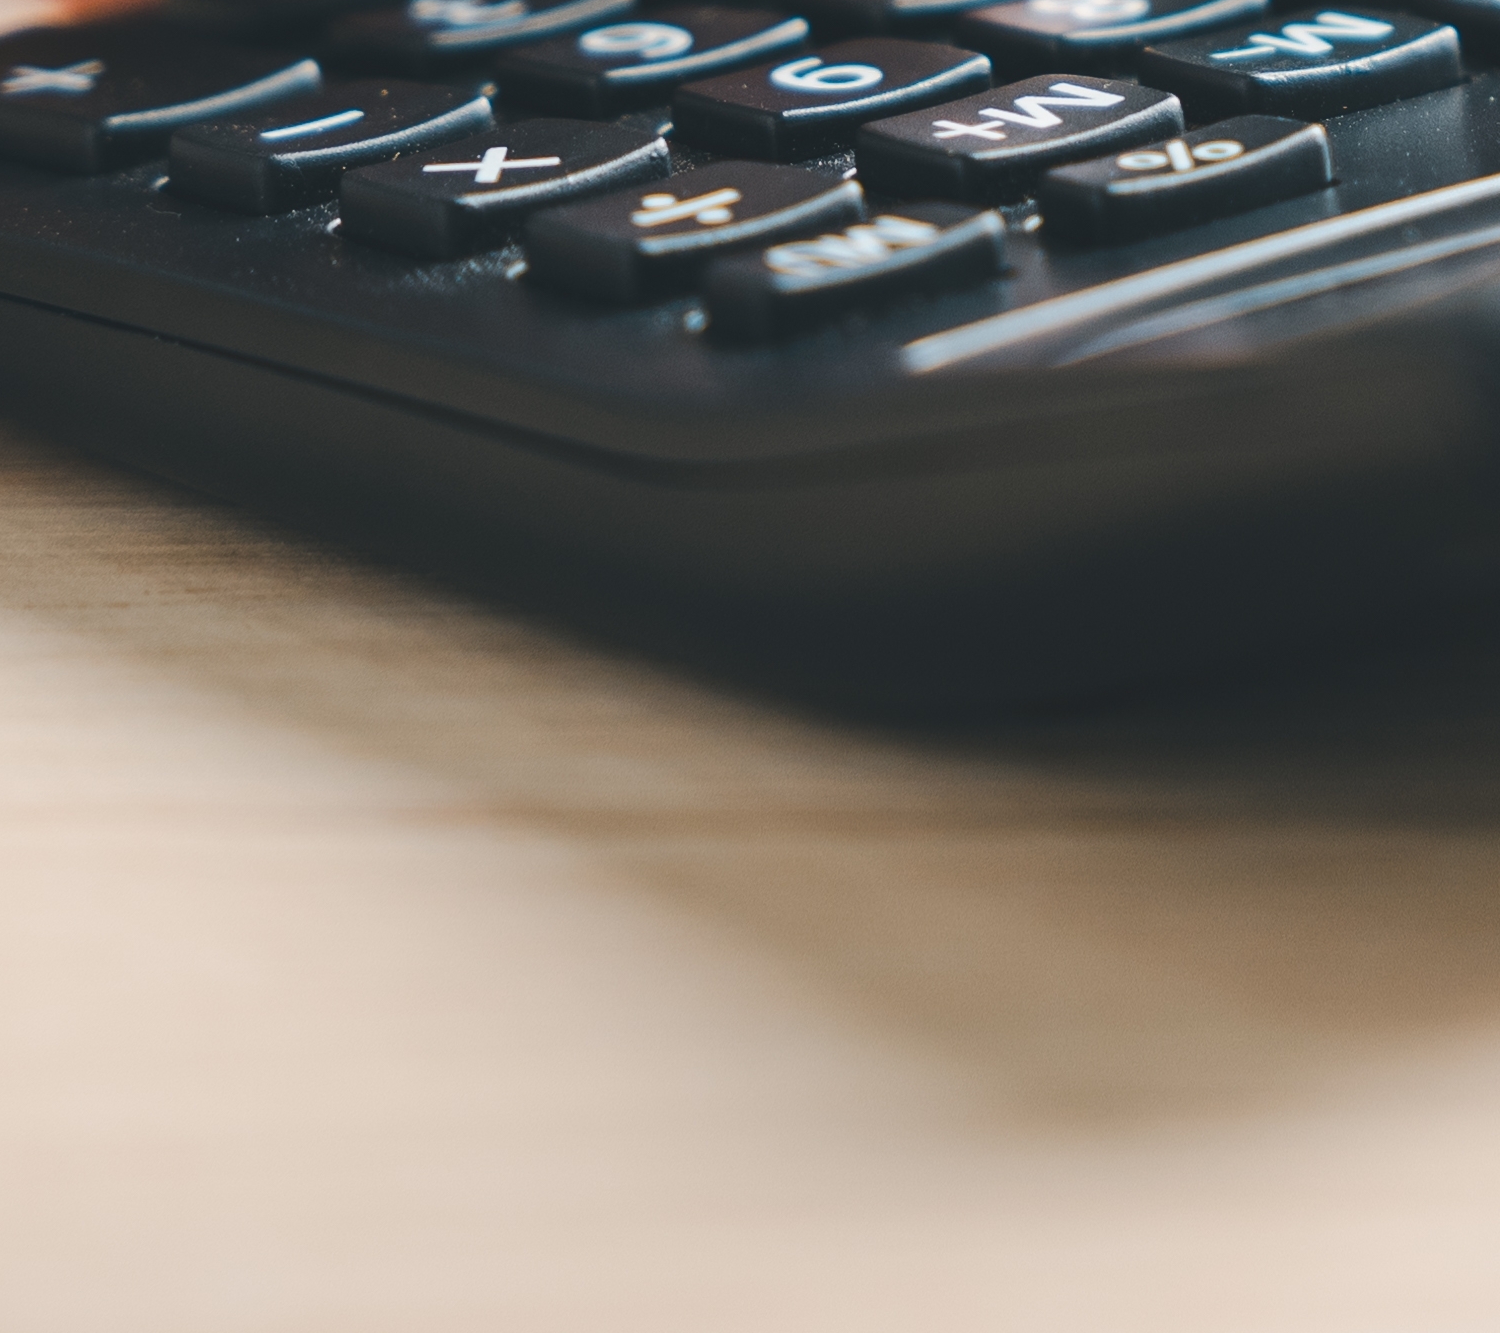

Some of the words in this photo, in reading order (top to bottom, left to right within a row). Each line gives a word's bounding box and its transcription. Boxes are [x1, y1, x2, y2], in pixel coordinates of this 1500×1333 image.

[579, 22, 692, 61] 6
[769, 56, 884, 93] 9
[931, 82, 1126, 141] M+
[1117, 137, 1244, 172] %
